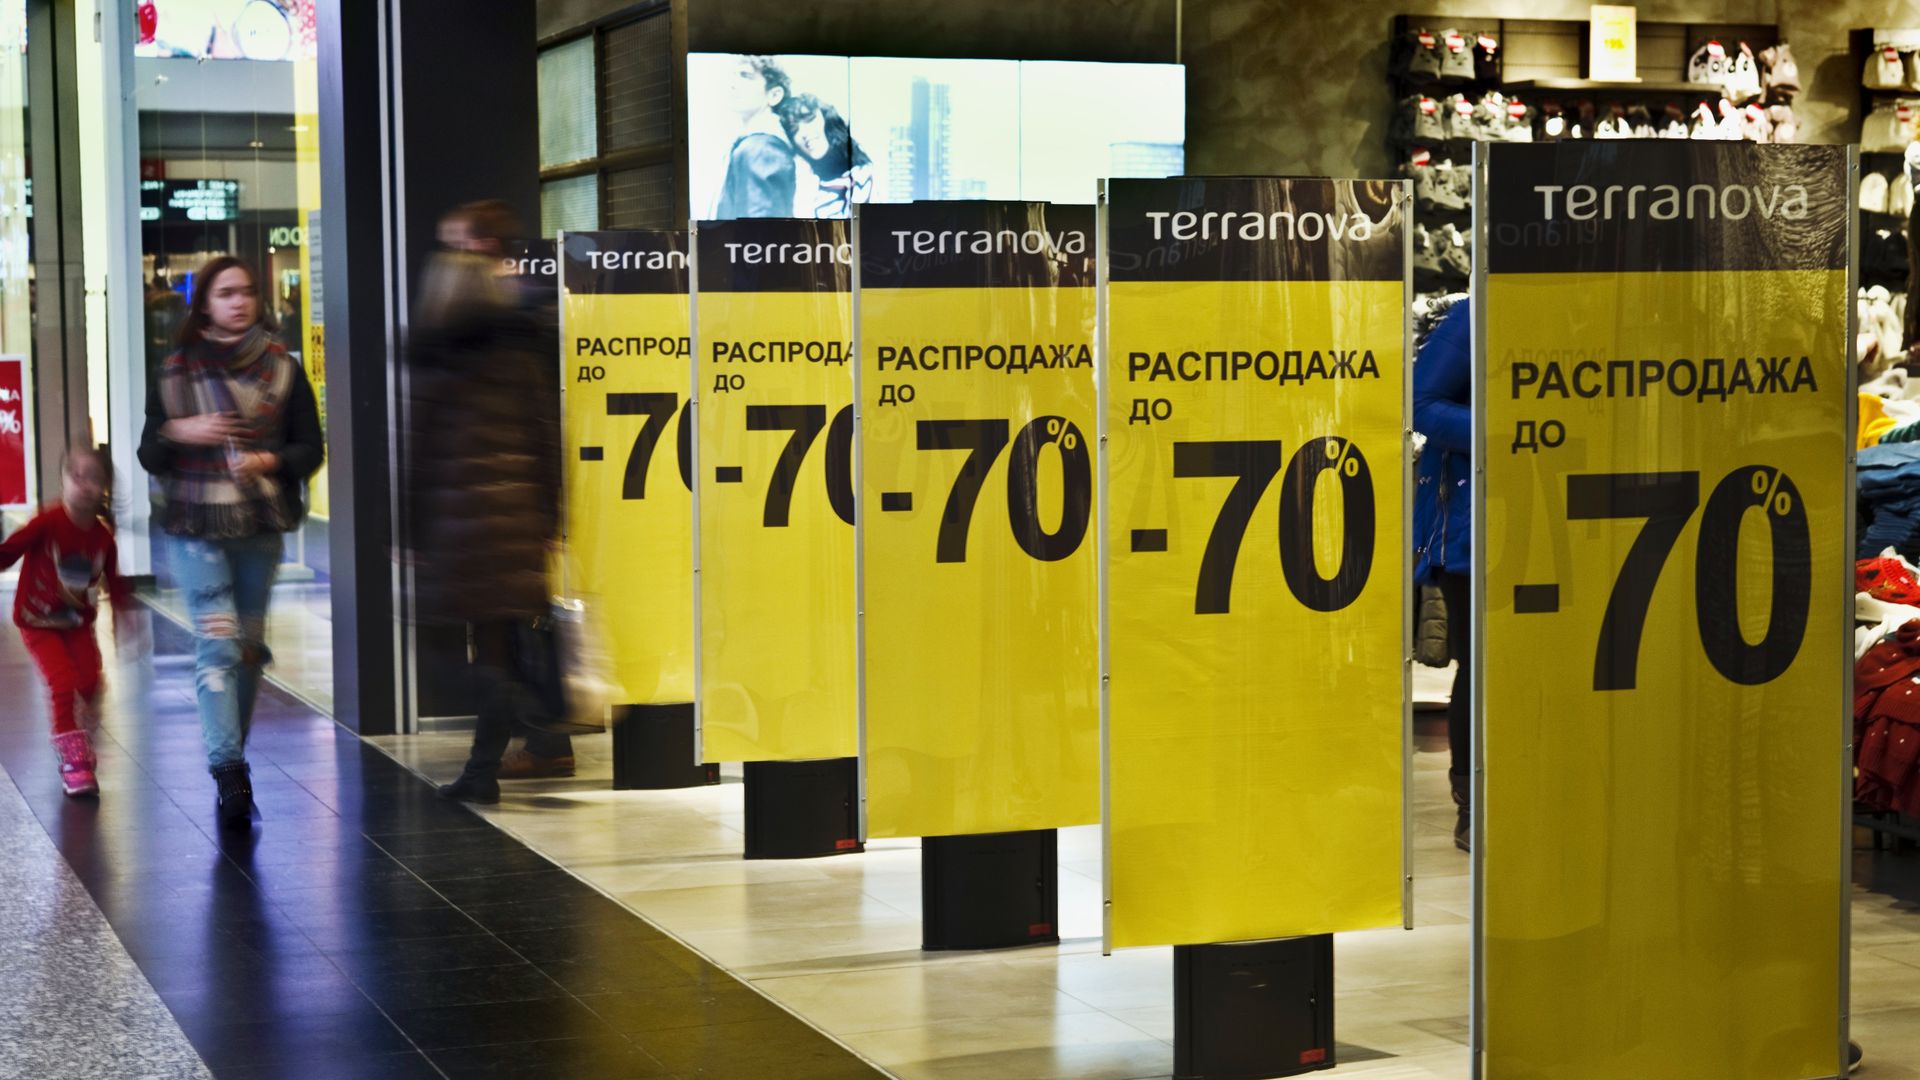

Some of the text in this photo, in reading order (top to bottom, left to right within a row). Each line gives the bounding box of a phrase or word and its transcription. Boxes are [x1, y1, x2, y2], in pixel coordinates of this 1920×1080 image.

[502, 257, 557, 275] erra
[585, 250, 690, 270] Terran
[576, 336, 691, 359] РАСПРОД
[878, 344, 1093, 374] РАСПРОДАЖА
[577, 365, 606, 383] ДО
[1128, 349, 1380, 386] РАСПРОДАЖА
[1511, 356, 1818, 403] РАСПРОДАЖА
[713, 374, 746, 393] ДО
[878, 384, 916, 407] ДО
[1128, 398, 1173, 425] ДО
[580, 392, 692, 500] -7
[1511, 419, 1567, 454] ДО
